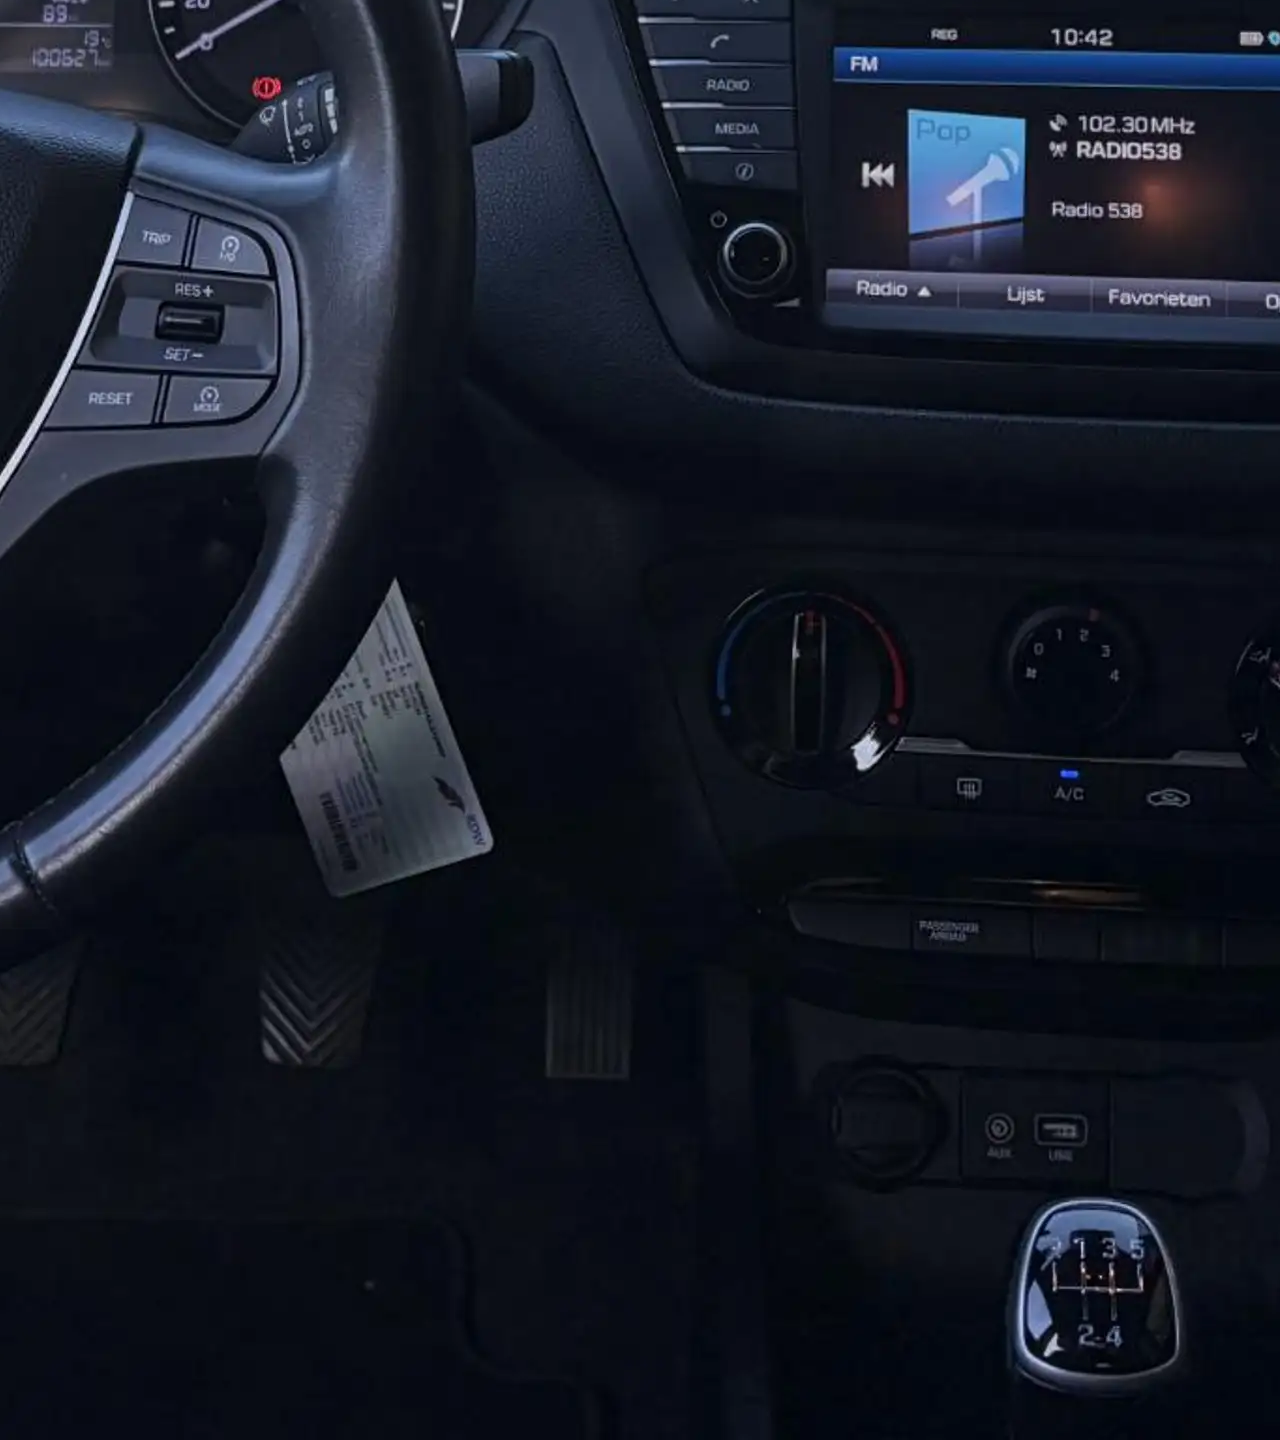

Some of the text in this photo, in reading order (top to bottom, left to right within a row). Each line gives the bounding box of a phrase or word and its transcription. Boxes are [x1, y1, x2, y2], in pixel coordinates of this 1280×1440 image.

[931, 29, 958, 41] REG
[1051, 28, 1114, 46] 10:42
[850, 56, 878, 72] FM
[706, 78, 750, 92] RADIO
[714, 122, 760, 136] MEDIA
[916, 118, 971, 146] Pop
[1076, 142, 1182, 160] RADIO538
[1051, 201, 1144, 220] Radio 538
[141, 229, 172, 245] TRIP
[856, 279, 908, 297] Radio
[1007, 285, 1046, 305] Lijst
[1108, 288, 1212, 308] Favorieten
[88, 391, 134, 405] RESET
[1054, 786, 1085, 801] A/C
[1072, 1237, 1086, 1260] 1
[1101, 1237, 1118, 1259] 3
[1130, 1239, 1146, 1260] 5
[1077, 1323, 1124, 1348] 2 4
